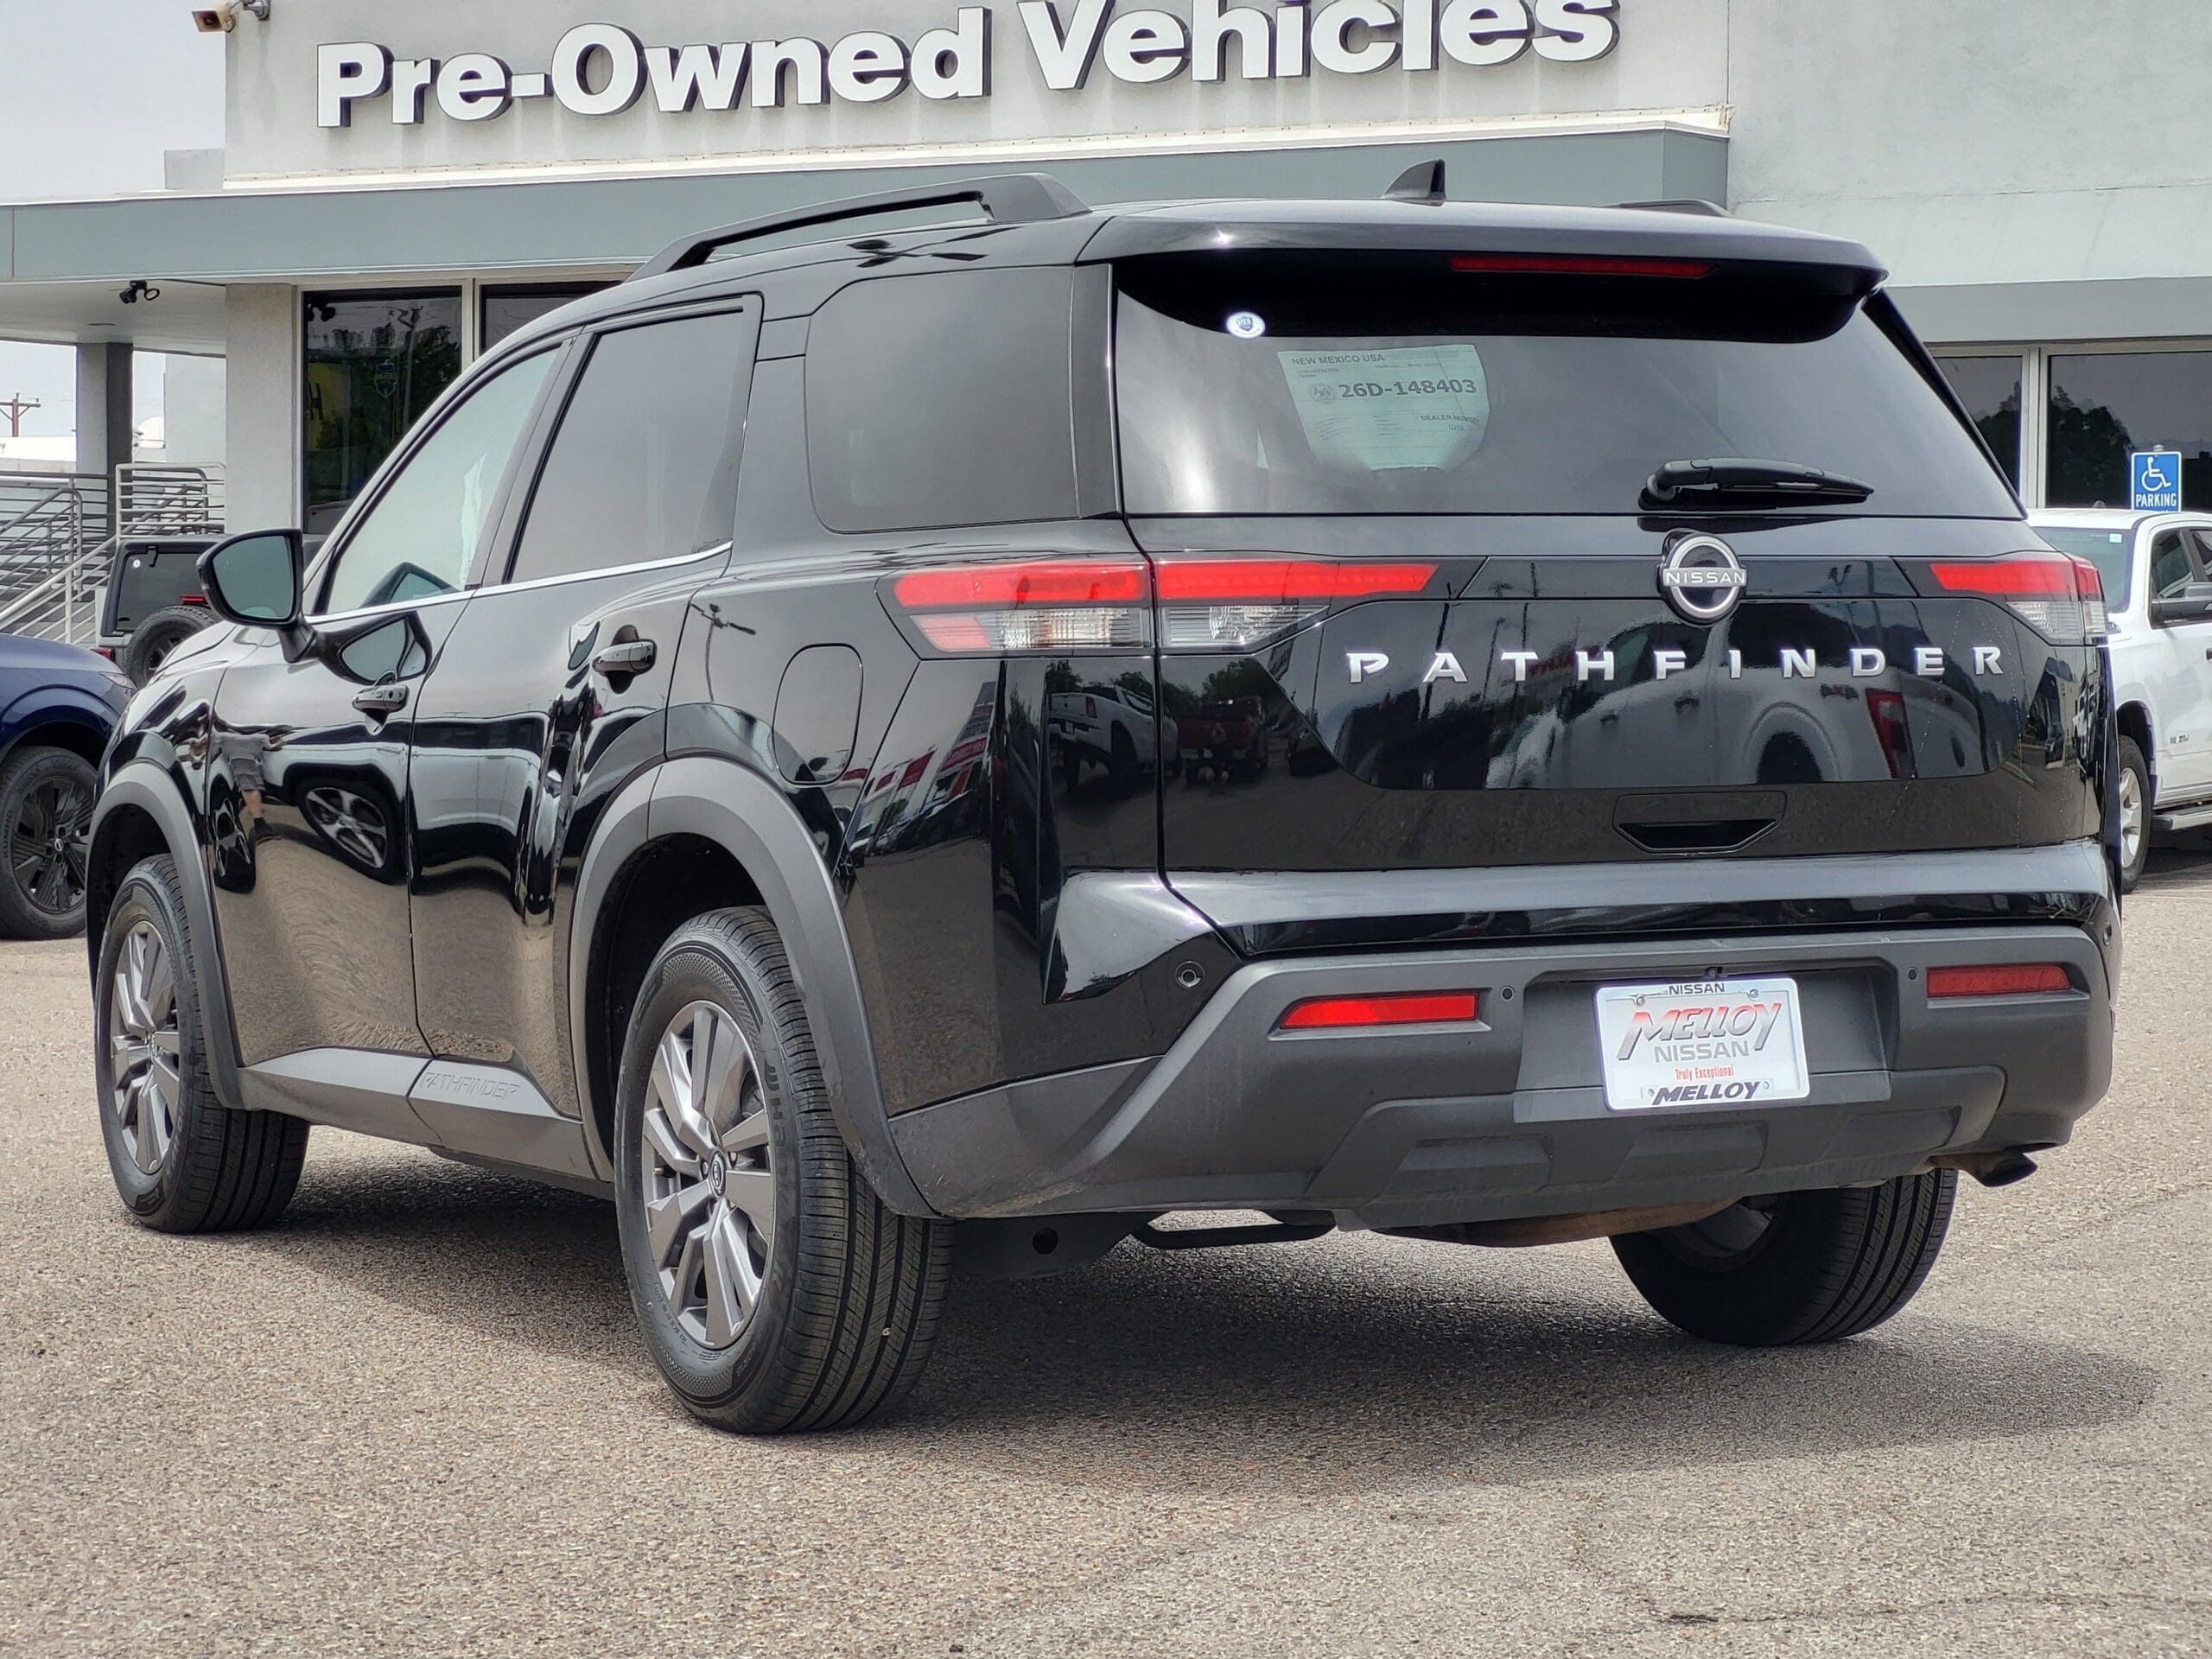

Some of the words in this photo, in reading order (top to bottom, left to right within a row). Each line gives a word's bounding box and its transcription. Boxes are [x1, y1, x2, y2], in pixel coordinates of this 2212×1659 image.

[316, 6, 991, 128] Pre-Owned
[1016, 0, 1619, 90] Vehicles
[1292, 357, 1316, 365] NEW
[1319, 354, 1360, 364] MEXICO
[1363, 353, 1385, 362] USA
[1338, 378, 1477, 397] 26D-148403
[2135, 493, 2177, 508] PARKING
[1666, 571, 1746, 585] NISSAN
[1345, 645, 2004, 684] PATHFINDER
[1668, 982, 1725, 995] NISSAN
[1616, 1002, 1782, 1061] MELLOY
[1654, 1040, 1750, 1063] NISSAN
[1675, 1066, 1694, 1081] Truly
[1694, 1065, 1734, 1079] Exceptional
[418, 1071, 520, 1100] PATHFINDER
[1651, 1081, 1761, 1105] MELLOY
